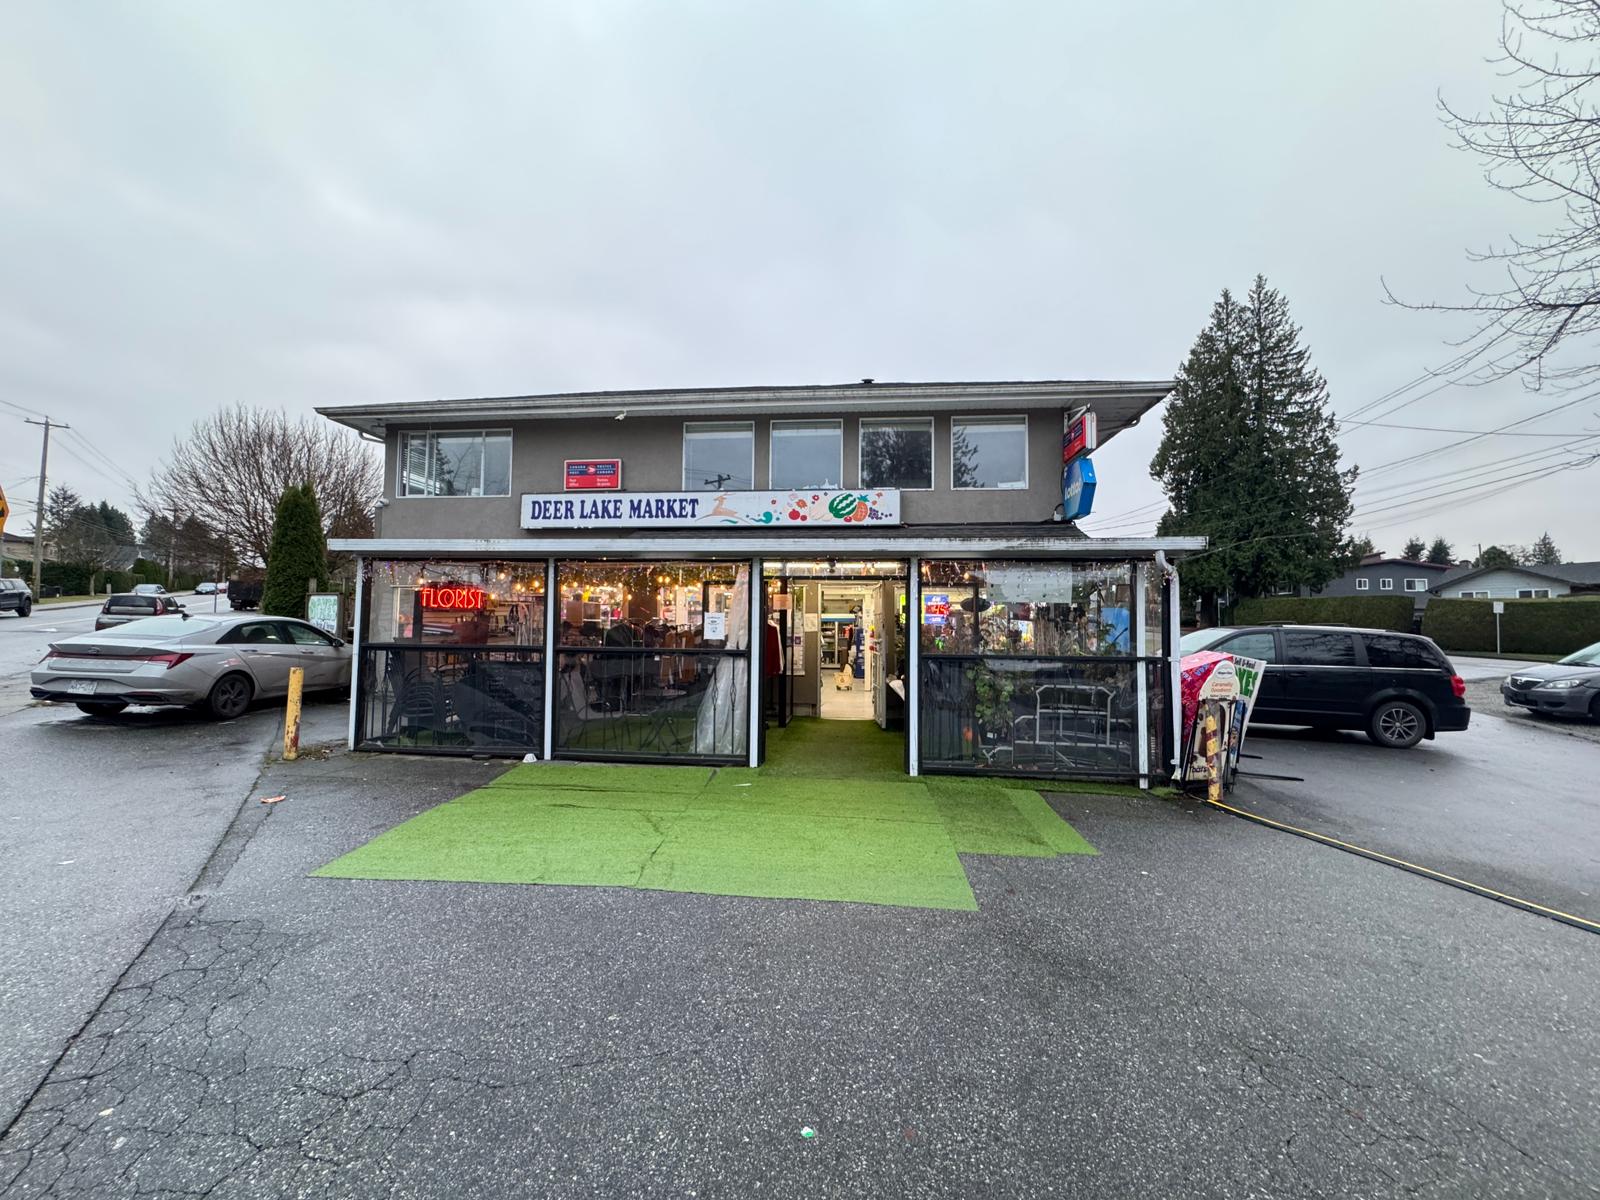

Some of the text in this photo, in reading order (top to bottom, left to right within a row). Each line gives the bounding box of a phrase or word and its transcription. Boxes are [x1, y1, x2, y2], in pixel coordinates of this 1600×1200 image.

[531, 498, 699, 520] DEER LAKE MARKET
[422, 588, 485, 609] FLORIST
